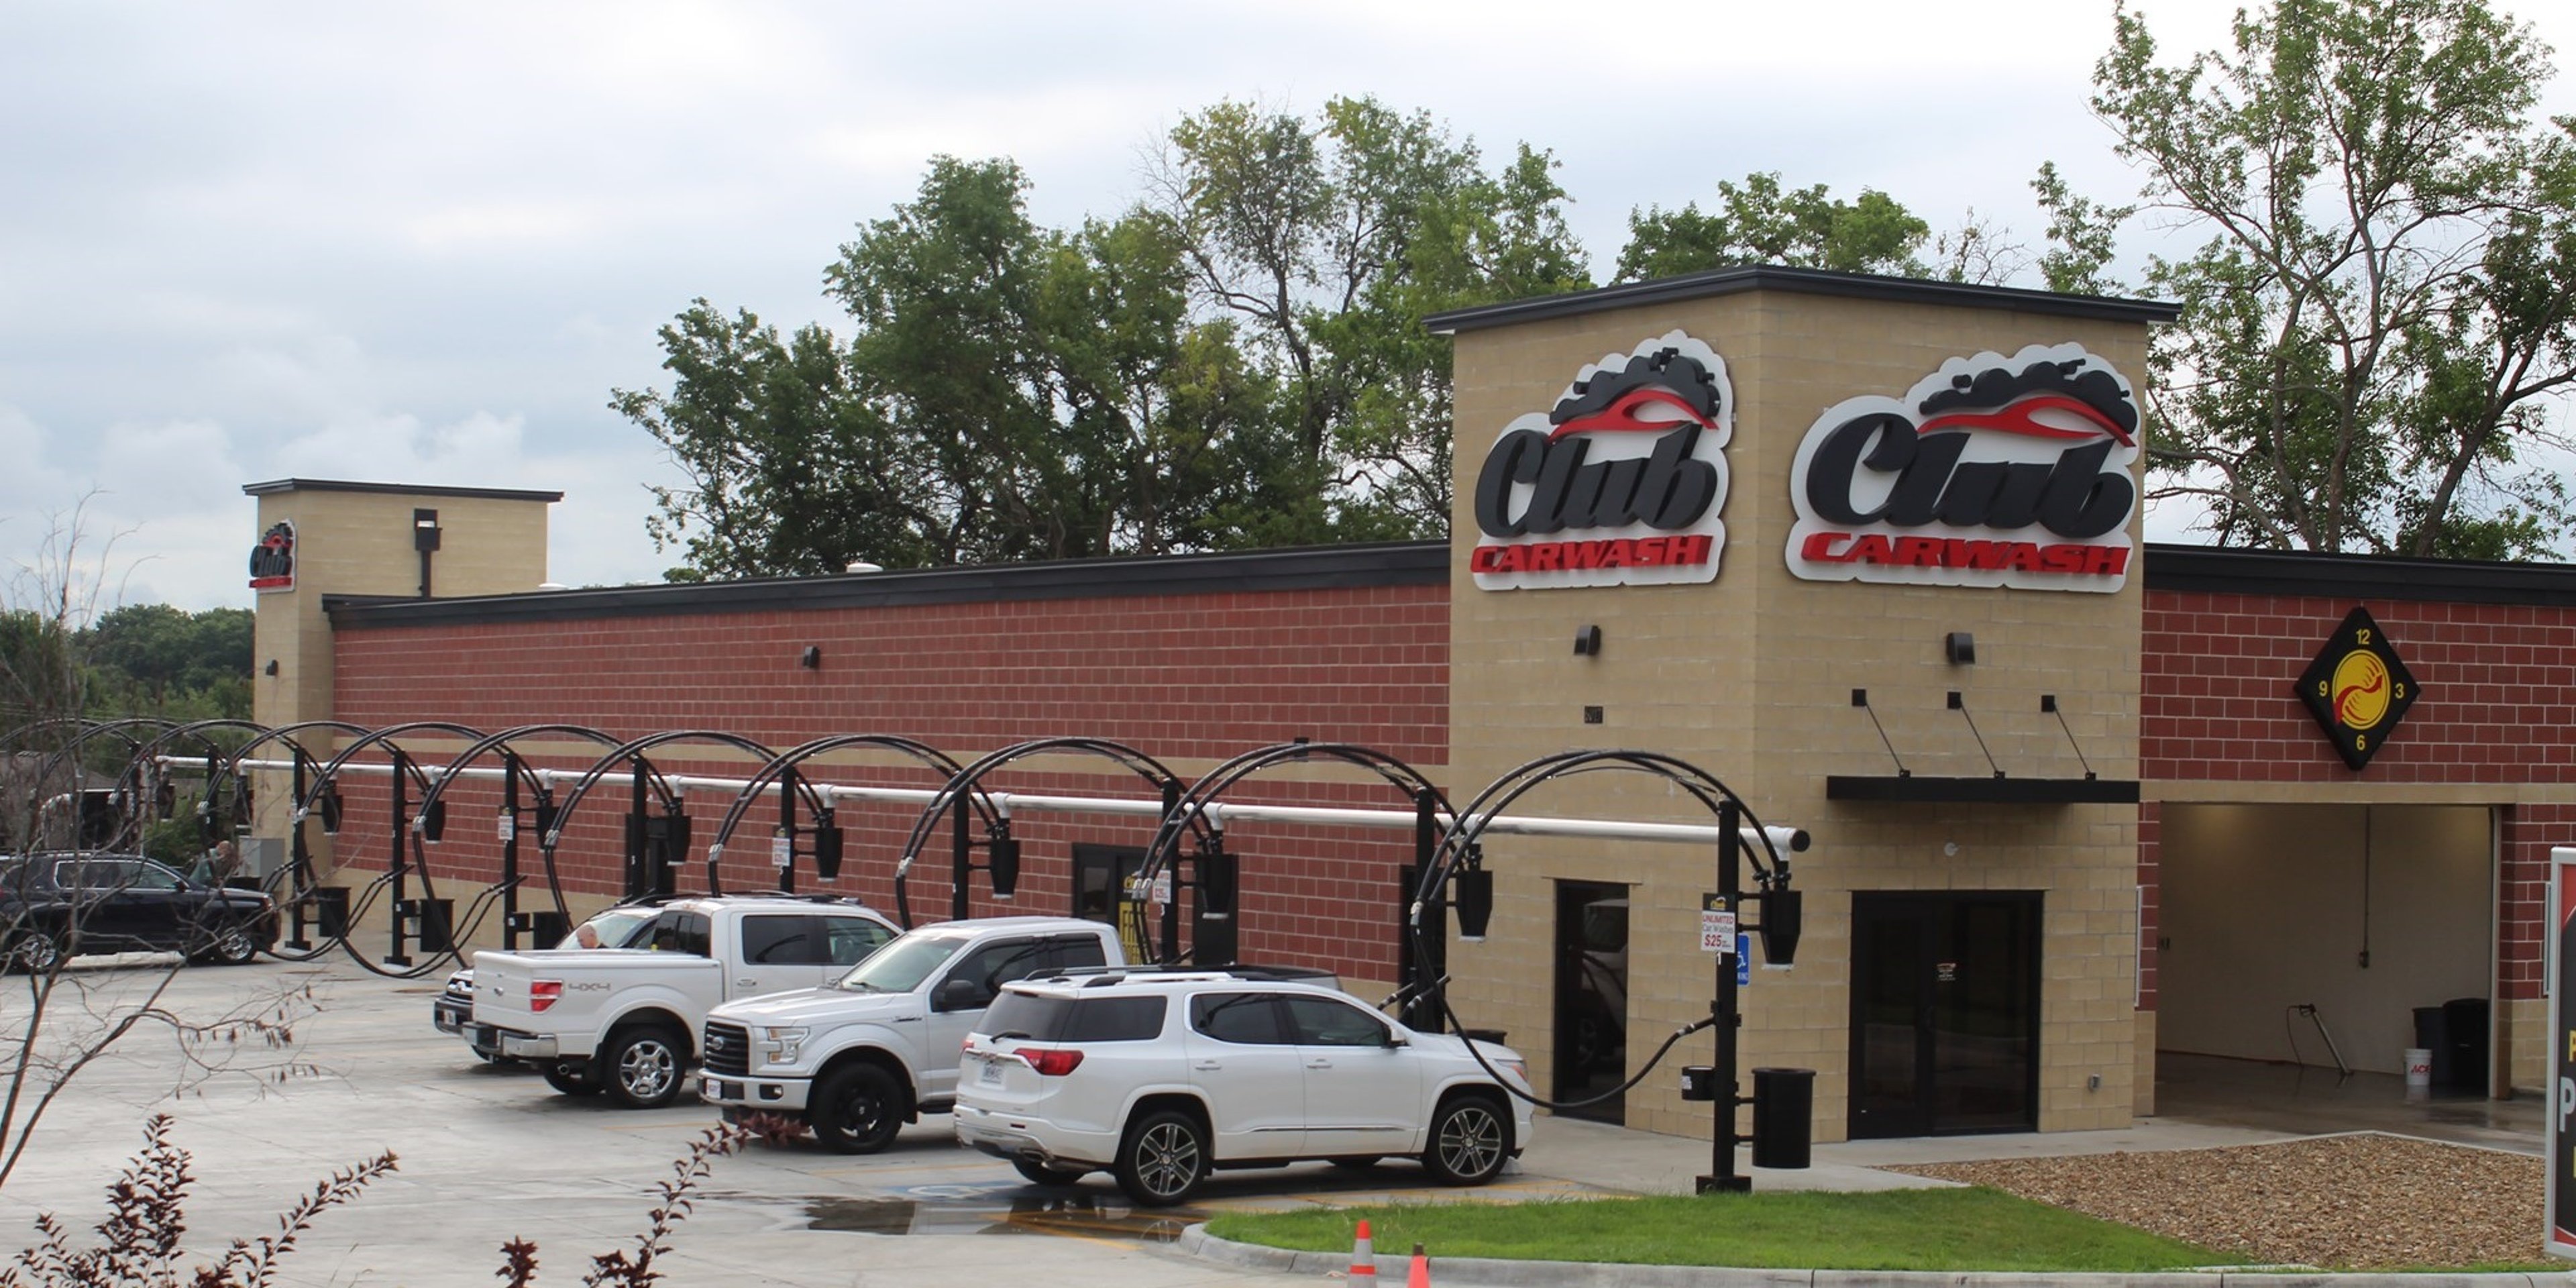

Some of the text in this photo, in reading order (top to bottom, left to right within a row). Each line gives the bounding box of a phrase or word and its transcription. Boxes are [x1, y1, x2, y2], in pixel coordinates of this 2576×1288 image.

[1474, 427, 1717, 537] Club
[1807, 413, 2134, 538] Club
[1470, 535, 1713, 573] CARWASH
[1801, 533, 2131, 575] CARWASH
[2356, 629, 2371, 645] 12
[2319, 680, 2328, 697] 9
[2395, 683, 2404, 699] 3
[2356, 735, 2365, 751] 6
[1702, 914, 1734, 924] UNLIMITED
[1705, 934, 1722, 947] $25
